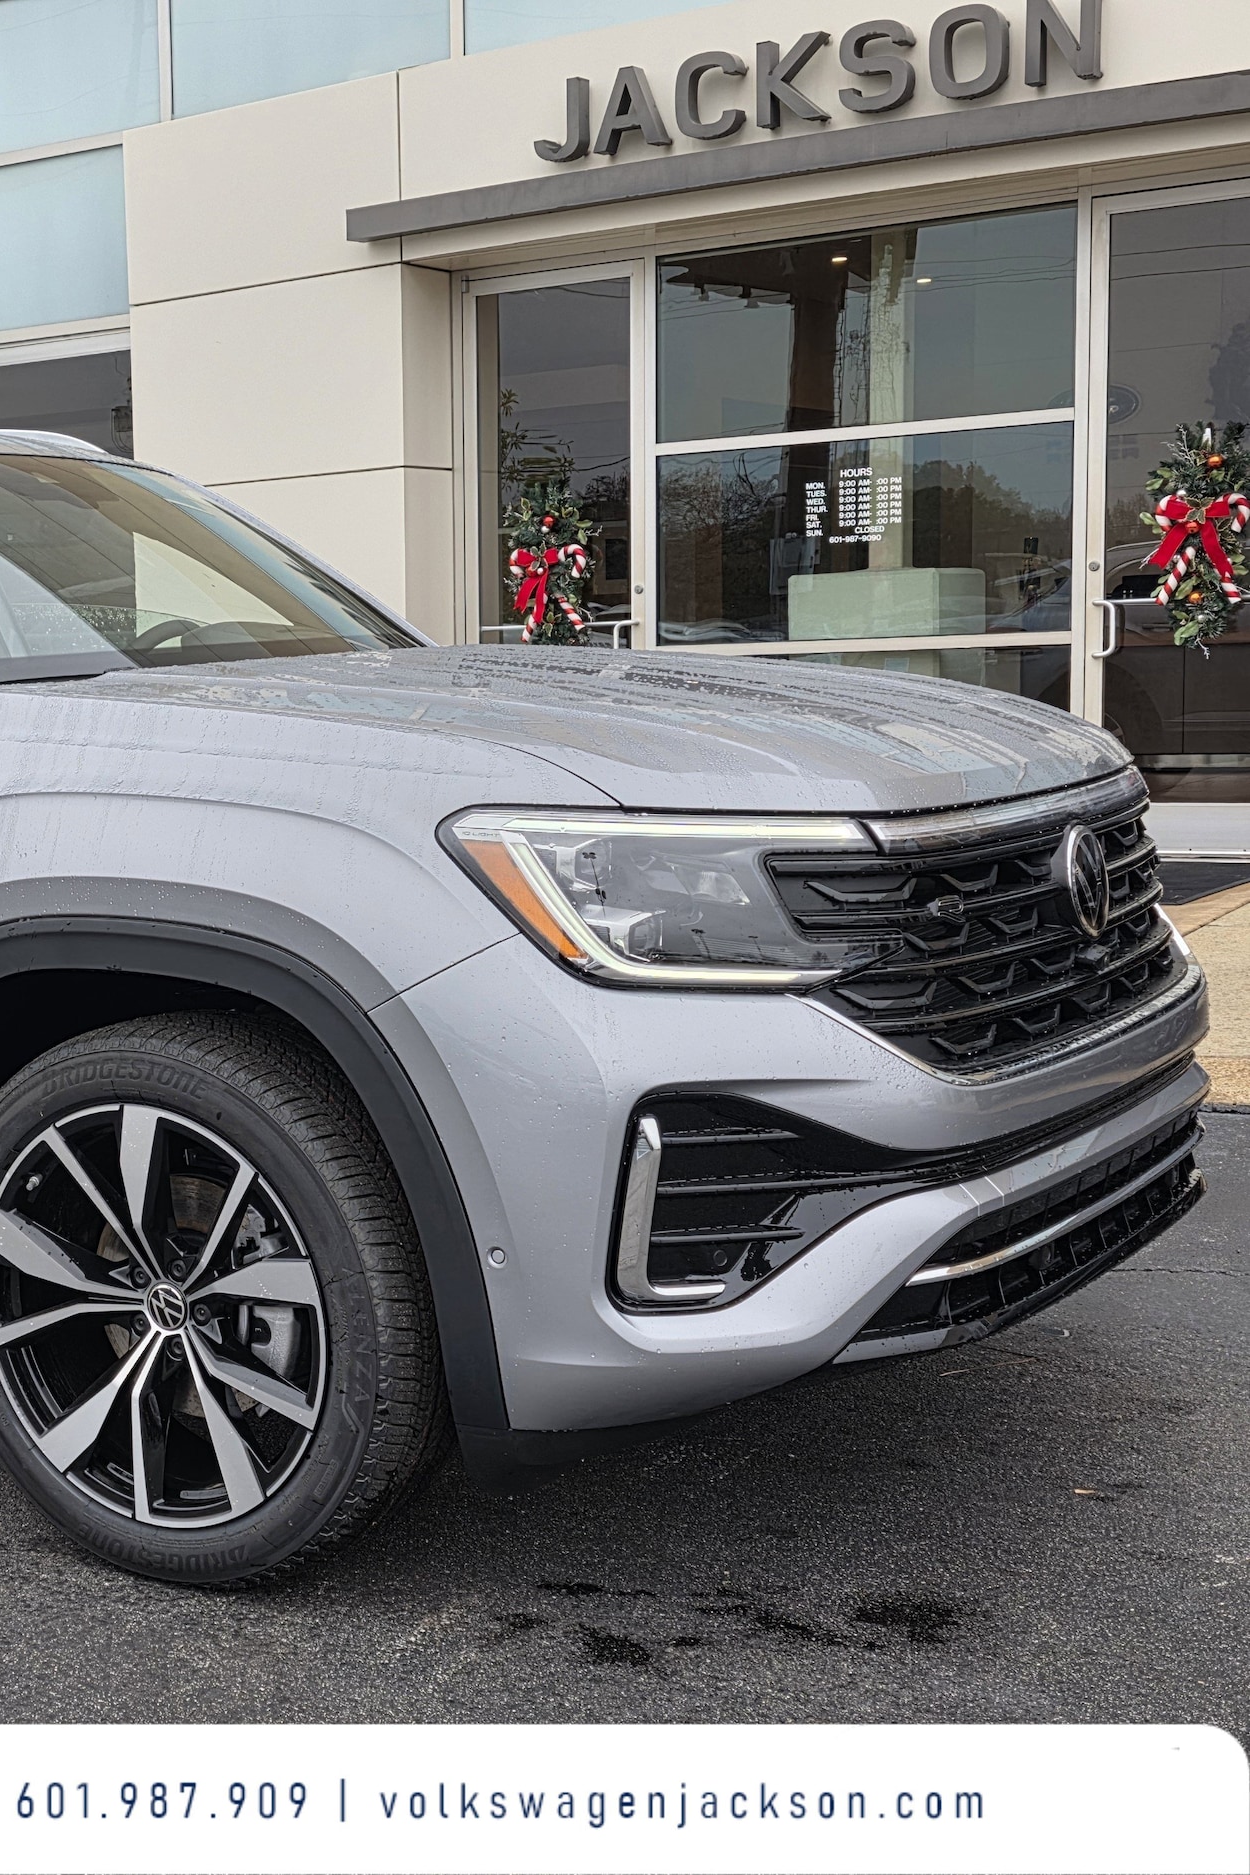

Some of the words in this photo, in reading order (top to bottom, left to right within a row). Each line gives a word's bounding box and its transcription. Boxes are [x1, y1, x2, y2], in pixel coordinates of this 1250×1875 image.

[534, 0, 1104, 163] JACKSON
[840, 467, 873, 478] HOURS
[806, 482, 825, 490] MON.
[839, 480, 856, 488] 9:00
[806, 490, 827, 498] TUES.
[839, 488, 856, 496] 9:00
[806, 498, 825, 506] WED.
[839, 496, 856, 504] 9:00
[890, 492, 902, 500] PM
[806, 506, 828, 514] THUR.
[839, 504, 856, 512] 9:00
[890, 500, 902, 508] PM
[839, 512, 856, 520] 9:00
[890, 508, 902, 516] PM
[806, 521, 822, 529] SAT.
[839, 520, 856, 528] 9:00
[890, 516, 902, 524] PM
[806, 529, 823, 537] SUN.
[854, 526, 884, 534] CLOSED
[829, 534, 882, 543] 601-987-9090
